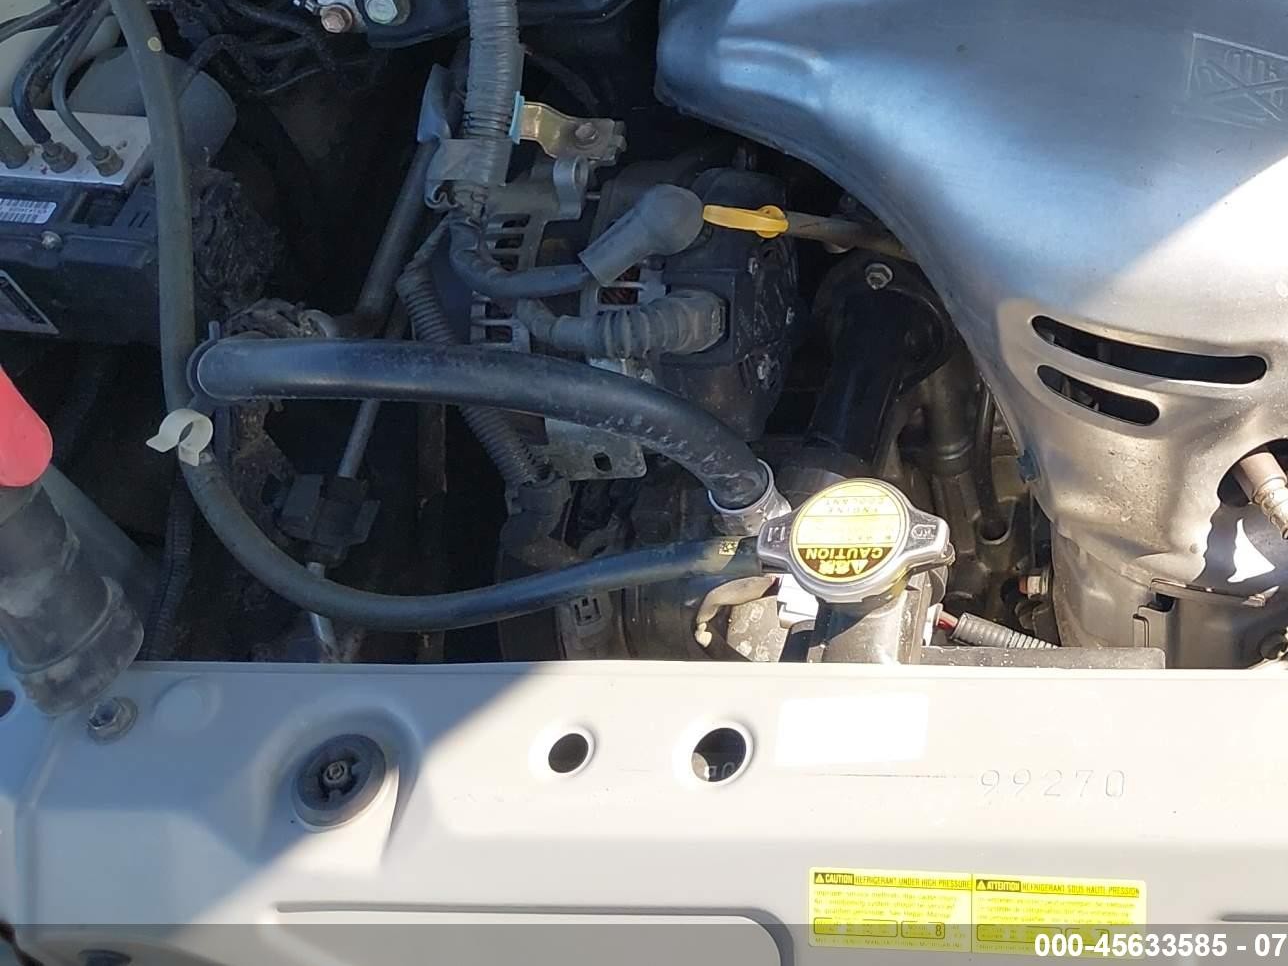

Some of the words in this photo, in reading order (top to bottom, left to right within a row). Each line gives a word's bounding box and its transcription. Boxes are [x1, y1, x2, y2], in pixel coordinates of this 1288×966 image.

[806, 546, 884, 560] CAUTION
[980, 769, 1125, 798] 99270
[825, 874, 853, 884] CAUTION
